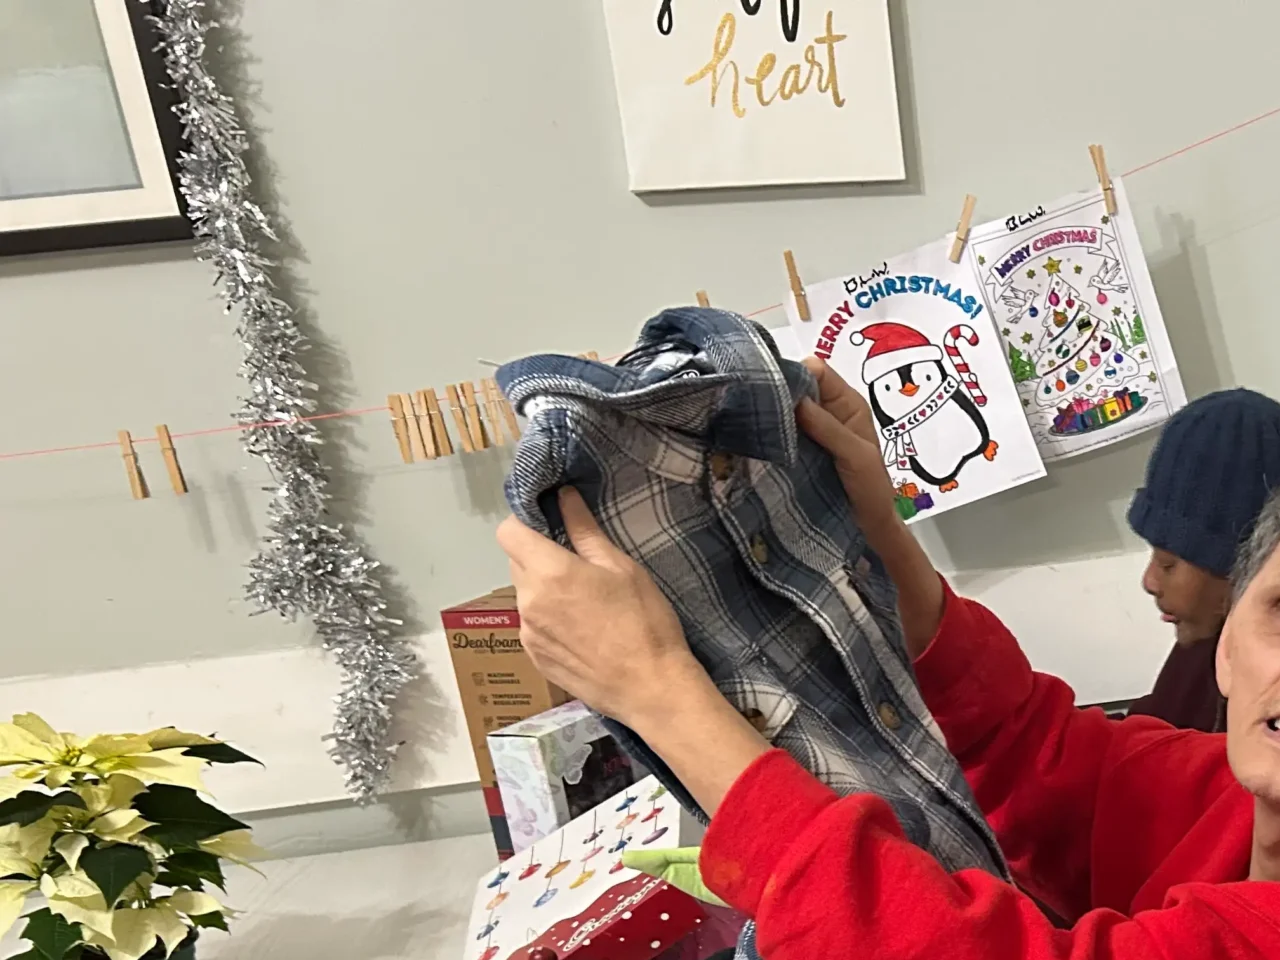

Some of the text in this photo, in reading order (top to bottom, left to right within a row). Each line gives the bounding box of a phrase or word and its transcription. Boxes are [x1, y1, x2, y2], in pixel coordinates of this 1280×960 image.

[683, 10, 847, 118] heart
[994, 228, 1097, 279] MERRY CHRISTMAS
[855, 275, 983, 320] CHRISTMAS!
[463, 615, 511, 625] WOMEN'S
